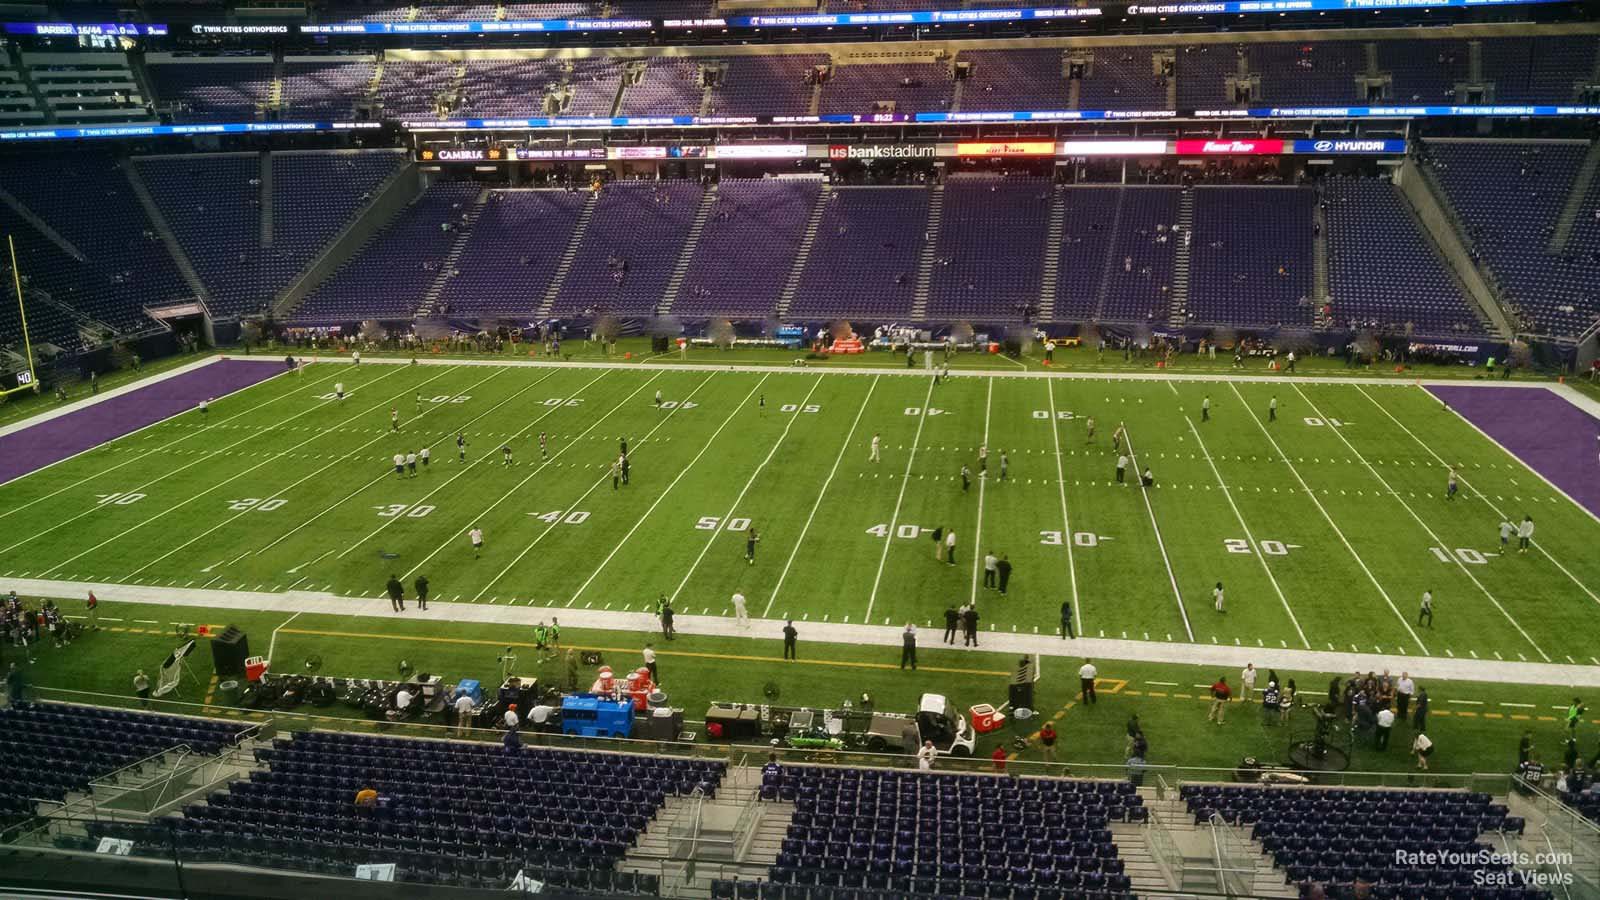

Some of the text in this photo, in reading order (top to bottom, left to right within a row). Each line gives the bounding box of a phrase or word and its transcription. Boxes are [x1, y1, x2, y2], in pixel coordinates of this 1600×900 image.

[1179, 4, 1225, 12] ORTHOPEDICS
[37, 26, 72, 34] BARBER
[77, 26, 102, 34] 16/44
[1335, 142, 1384, 150] HYUNDAI
[438, 150, 484, 159] CAMBRIA
[18, 373, 30, 384] 40
[97, 493, 148, 504] 10
[228, 498, 288, 510] 20
[377, 504, 436, 517] 30
[536, 511, 591, 524] 40
[694, 517, 752, 531] 50
[865, 524, 919, 538] 40
[1040, 530, 1098, 546] 30
[1224, 539, 1288, 555] 20
[1429, 547, 1488, 564] 10
[1526, 771, 1540, 780] 28
